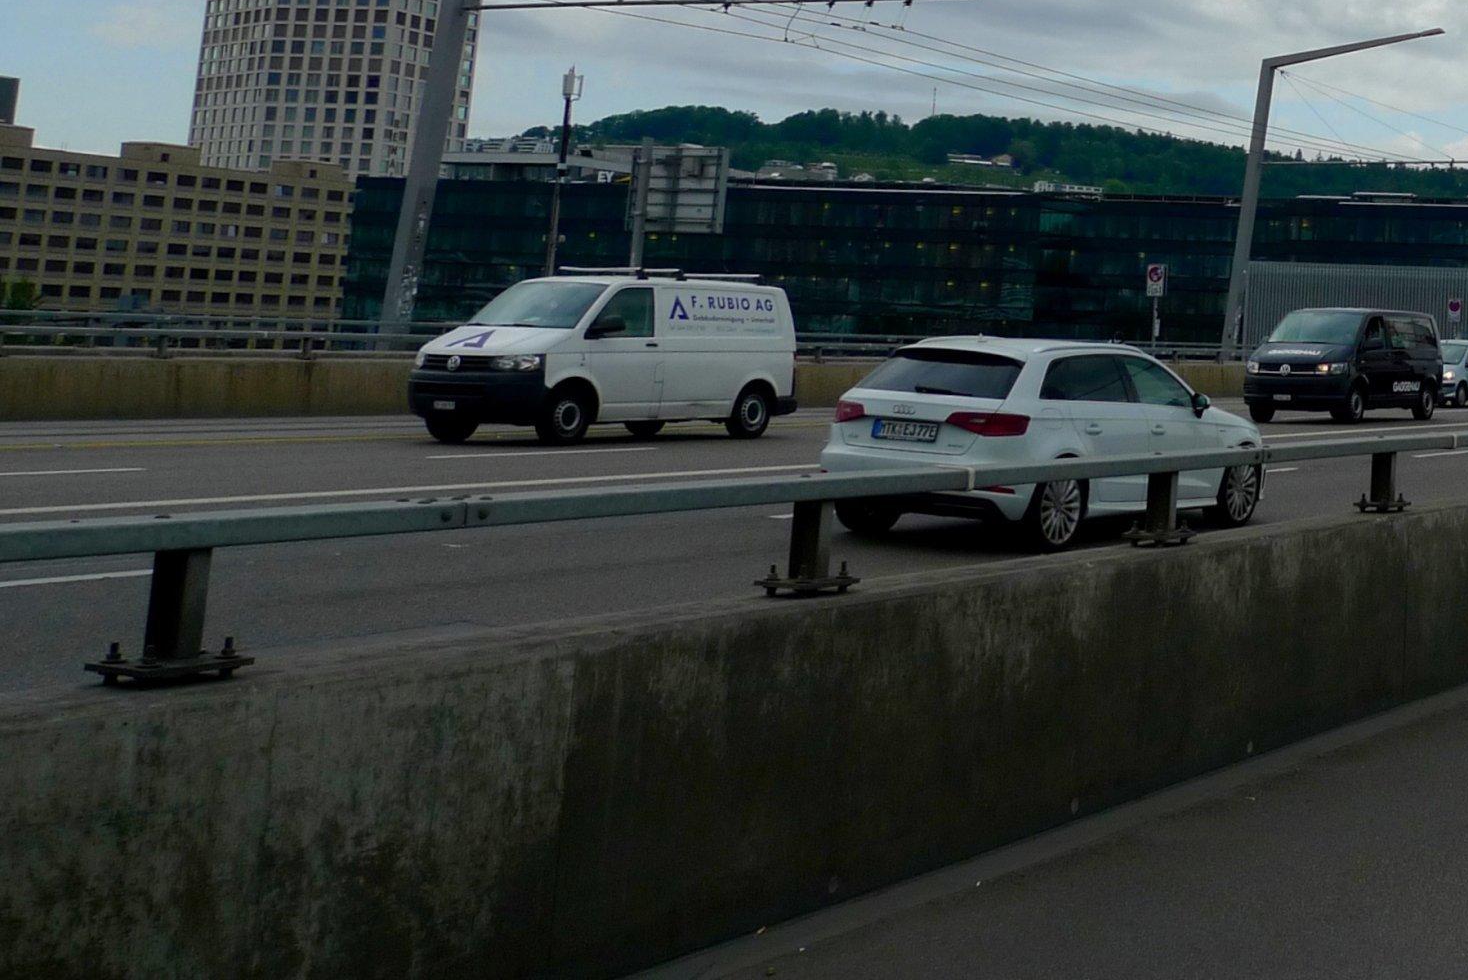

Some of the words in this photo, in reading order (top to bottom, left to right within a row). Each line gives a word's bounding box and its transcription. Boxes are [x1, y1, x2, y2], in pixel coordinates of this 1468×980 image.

[597, 171, 615, 183] EY
[691, 295, 704, 308] F.
[708, 296, 751, 310] RUBIO
[756, 299, 774, 312] AG
